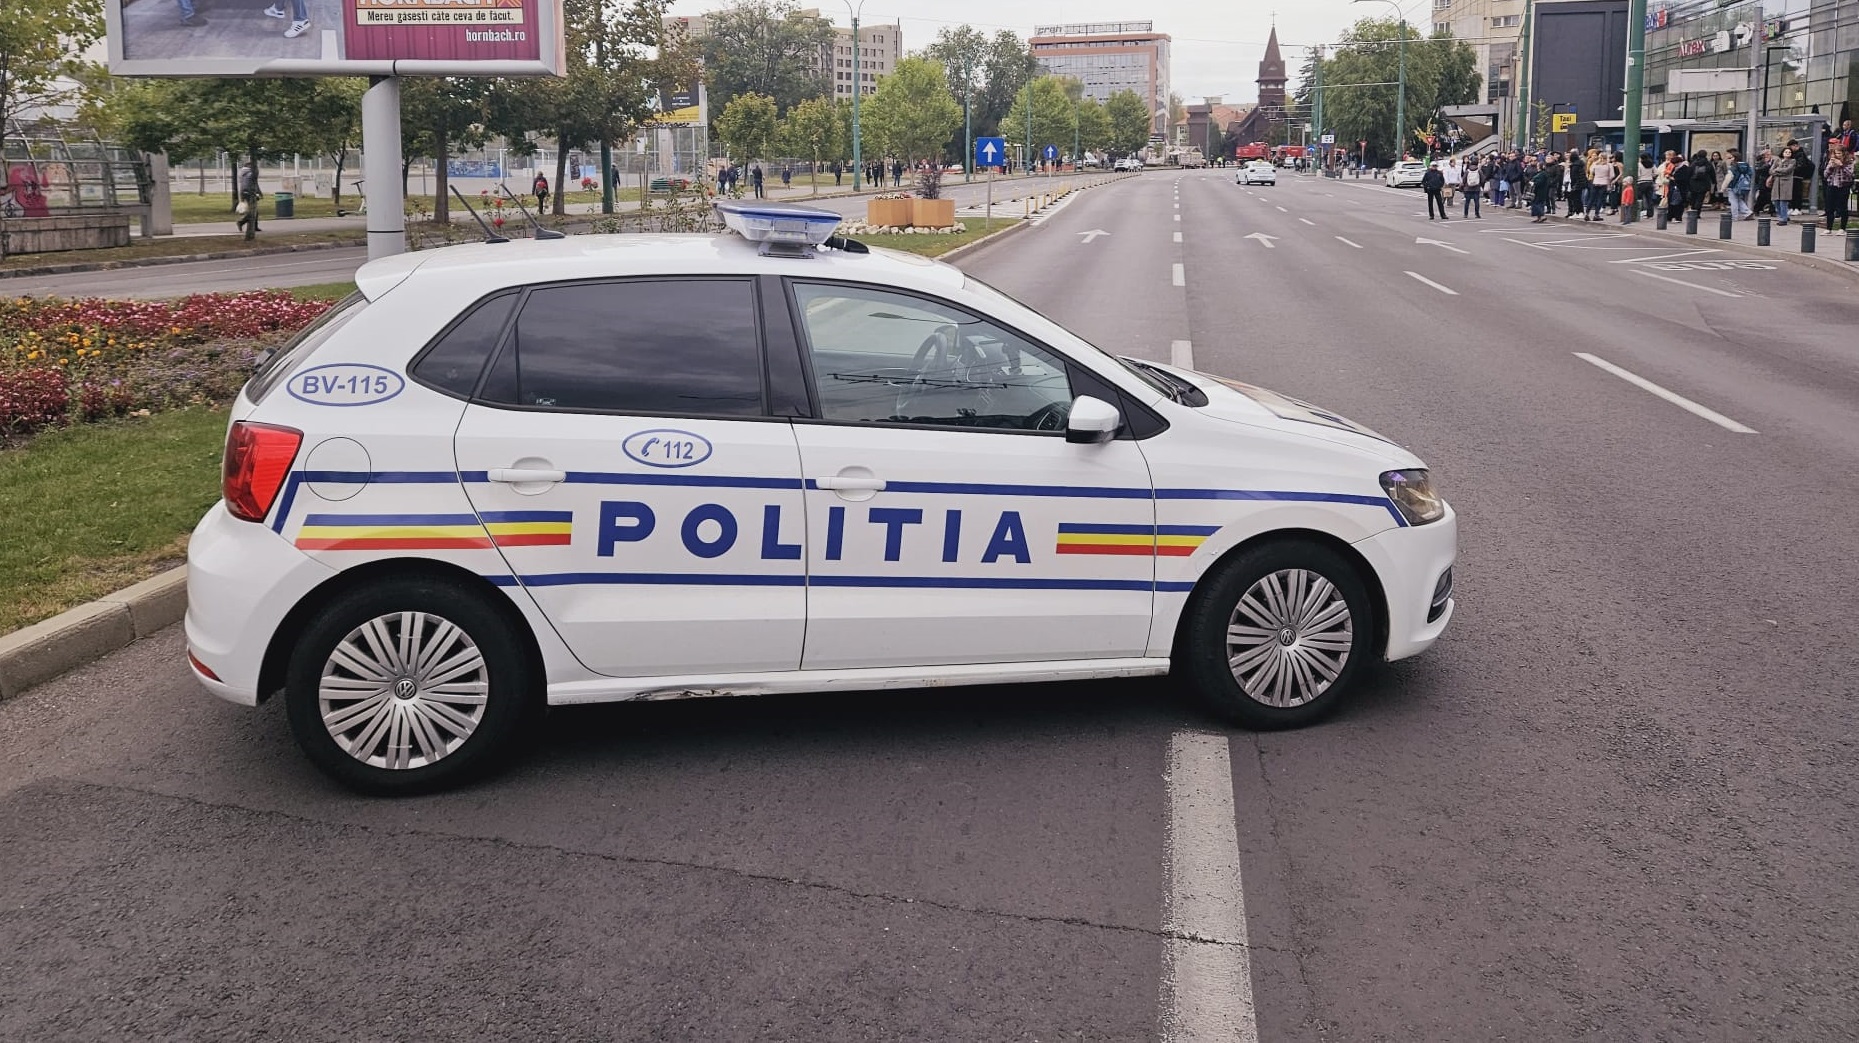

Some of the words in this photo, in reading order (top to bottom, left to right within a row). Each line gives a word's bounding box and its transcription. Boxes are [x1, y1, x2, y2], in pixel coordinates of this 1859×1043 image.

[367, 10, 394, 21] Mereu
[453, 11, 473, 21] ceva
[476, 10, 486, 21] de
[465, 28, 526, 42] hornbach.ro
[302, 375, 388, 394] BV-115
[663, 440, 694, 459] 112
[597, 500, 1032, 564] POLITIA
